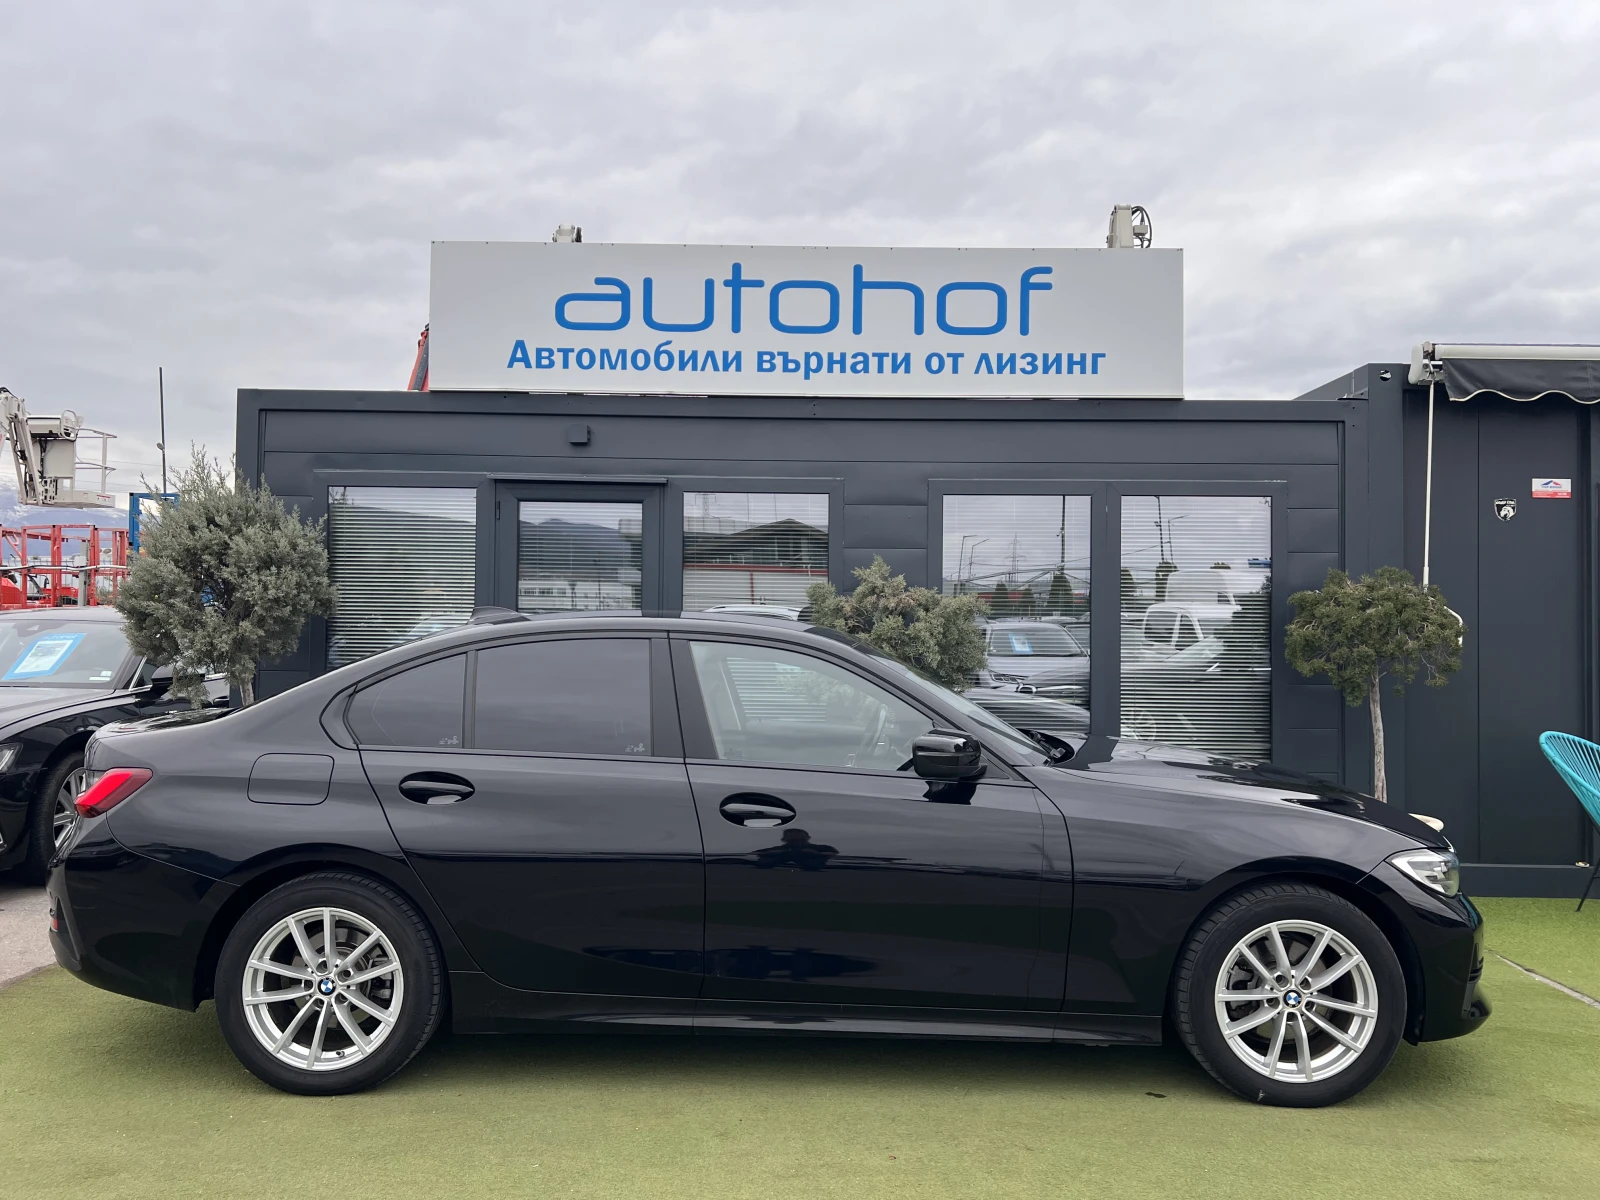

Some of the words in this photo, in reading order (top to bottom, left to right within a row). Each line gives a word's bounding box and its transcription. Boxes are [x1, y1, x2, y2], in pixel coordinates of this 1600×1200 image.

[554, 262, 1054, 337] autohof
[507, 339, 743, 373] Автомобили
[756, 350, 912, 381] върнати
[924, 351, 965, 375] от
[973, 352, 1107, 376] лизинг
